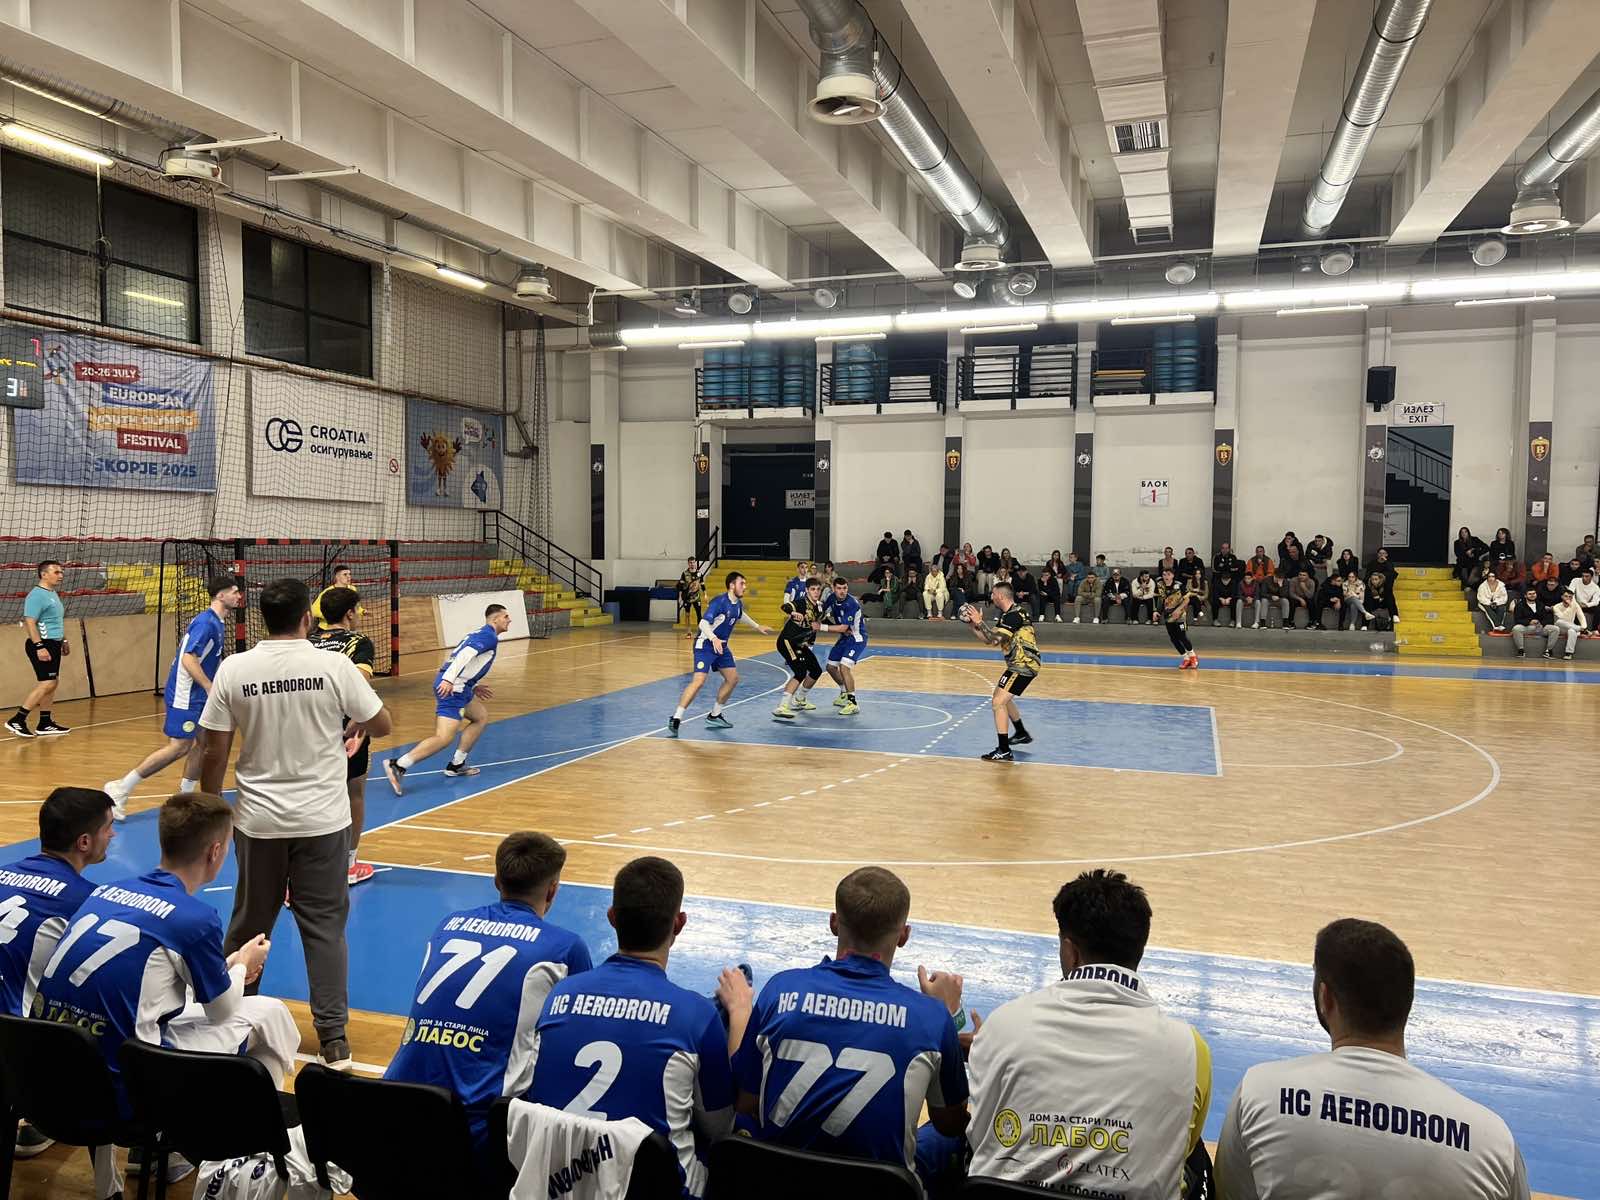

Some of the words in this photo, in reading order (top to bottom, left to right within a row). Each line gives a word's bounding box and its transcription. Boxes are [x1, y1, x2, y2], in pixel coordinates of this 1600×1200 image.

[112, 368, 137, 379] JULY
[109, 387, 184, 408] EUROPEAN
[1409, 415, 1429, 424] EXIT
[123, 433, 182, 449] FESTIVAL
[310, 424, 366, 444] CROATIA
[310, 444, 373, 460] осигурување
[95, 457, 158, 475] SKOPJE
[161, 463, 197, 477] 2025
[1141, 480, 1168, 488] БЛОК
[1151, 489, 1156, 503] 1
[242, 683, 258, 698] HC
[261, 677, 324, 695] AERODROM
[99, 886, 177, 920] AERODROM
[443, 916, 464, 931] HC
[461, 918, 541, 943] AERODROM
[44, 913, 140, 988] 17
[416, 938, 518, 1010] 71
[549, 993, 570, 1015] HC
[571, 994, 671, 1025] AERODROM
[777, 991, 799, 1014] HC
[801, 992, 907, 1028] AERODROM
[419, 1018, 433, 1026] ДОМ
[444, 1021, 466, 1031] СТАРИ
[467, 1025, 489, 1036] ЛИЦА
[415, 1026, 485, 1053] ЛАБОС
[563, 1040, 623, 1121] 2
[769, 1038, 896, 1137] 77
[1029, 1113, 1051, 1122] ДОМ
[1054, 1114, 1066, 1123] ЗА
[1069, 1116, 1101, 1125] СТАРИ
[1104, 1118, 1133, 1130] ЛИЦА
[1279, 1087, 1311, 1117] HC
[1320, 1093, 1470, 1152] AERODROM
[1030, 1123, 1129, 1153] ЛАБОС
[1078, 1161, 1131, 1182] ZLATEX
